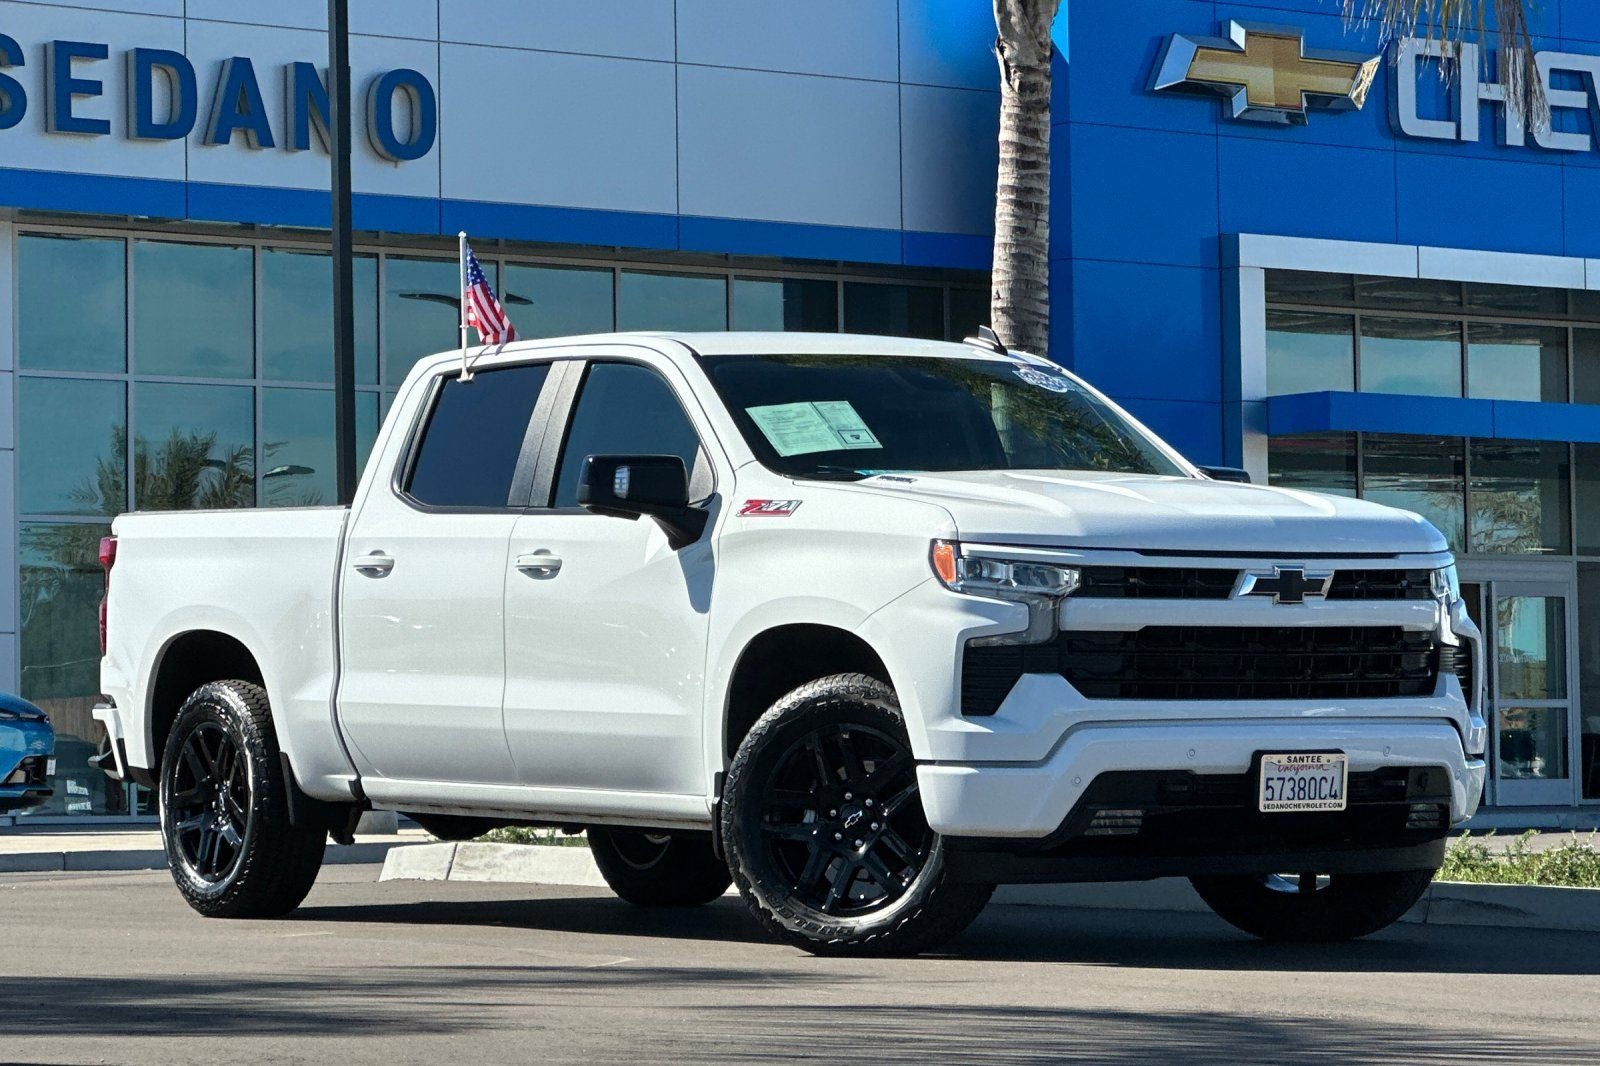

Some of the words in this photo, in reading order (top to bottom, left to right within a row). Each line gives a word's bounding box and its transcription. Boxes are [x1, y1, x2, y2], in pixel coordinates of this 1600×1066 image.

[1392, 37, 1600, 151] CHE
[1286, 755, 1322, 763] SANTEE
[1265, 776, 1338, 801] 57380C4
[1263, 802, 1343, 810] SEDANOCHEVROLET.COM
